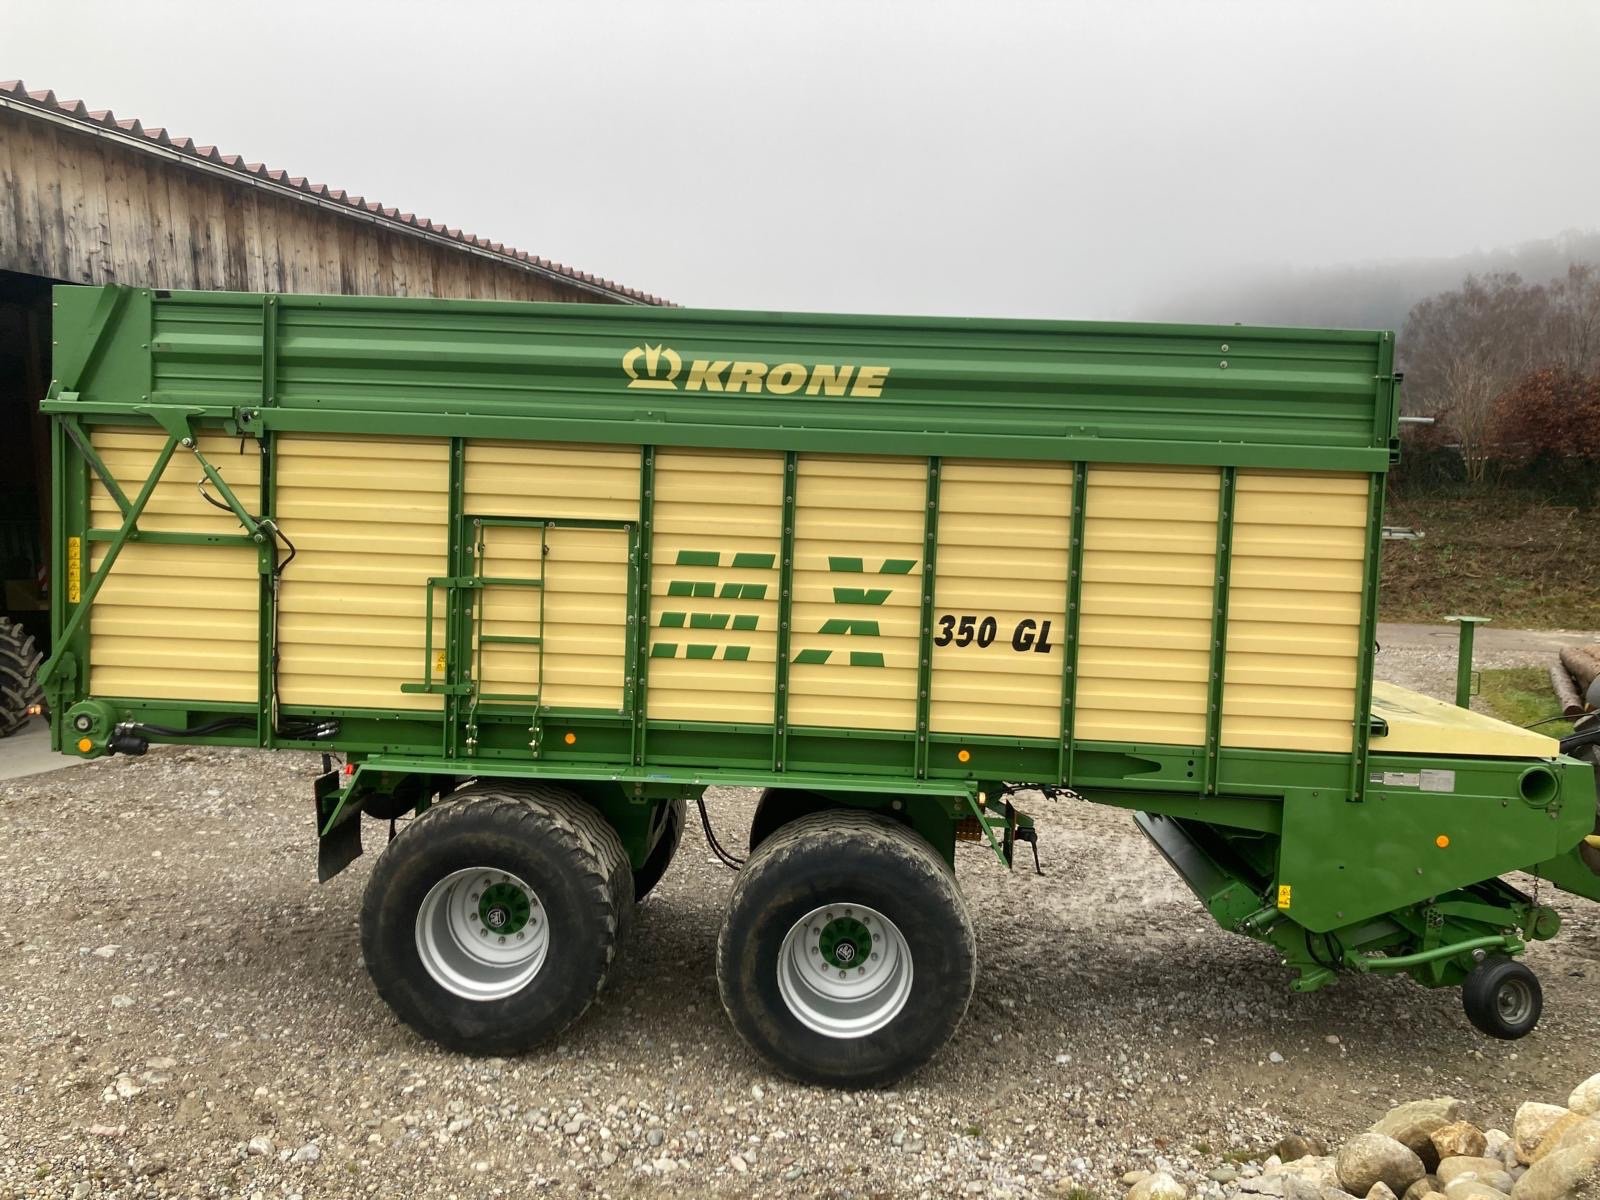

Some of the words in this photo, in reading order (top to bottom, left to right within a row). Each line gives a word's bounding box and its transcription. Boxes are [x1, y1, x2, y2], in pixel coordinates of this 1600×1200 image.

[685, 360, 890, 397] KRONE
[934, 614, 997, 648] 350
[1012, 618, 1051, 653] GL
